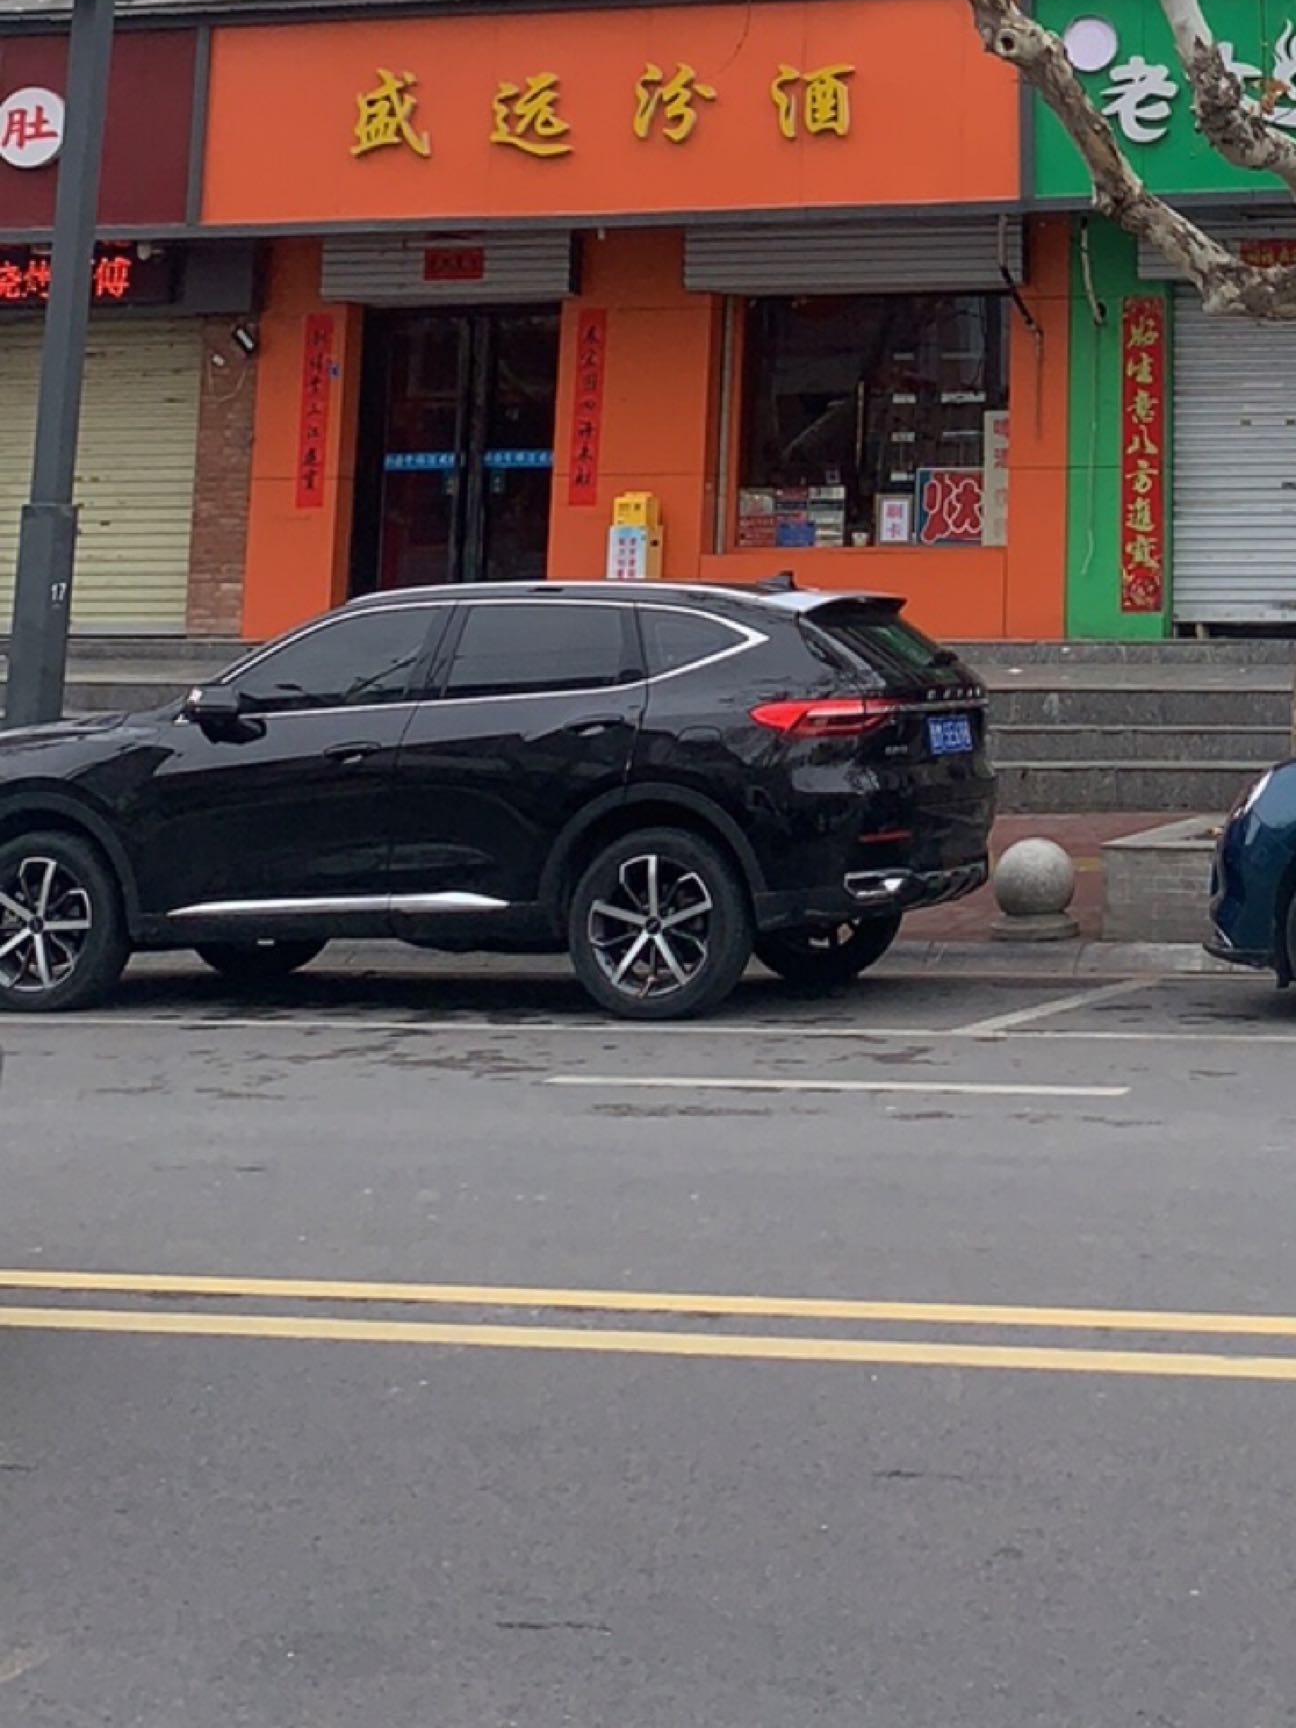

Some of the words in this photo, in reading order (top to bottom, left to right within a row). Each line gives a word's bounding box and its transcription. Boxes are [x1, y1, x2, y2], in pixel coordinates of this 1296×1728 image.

[0, 106, 59, 149] 肚
[350, 62, 856, 158] 盛远汾酒
[51, 582, 67, 601] 17
